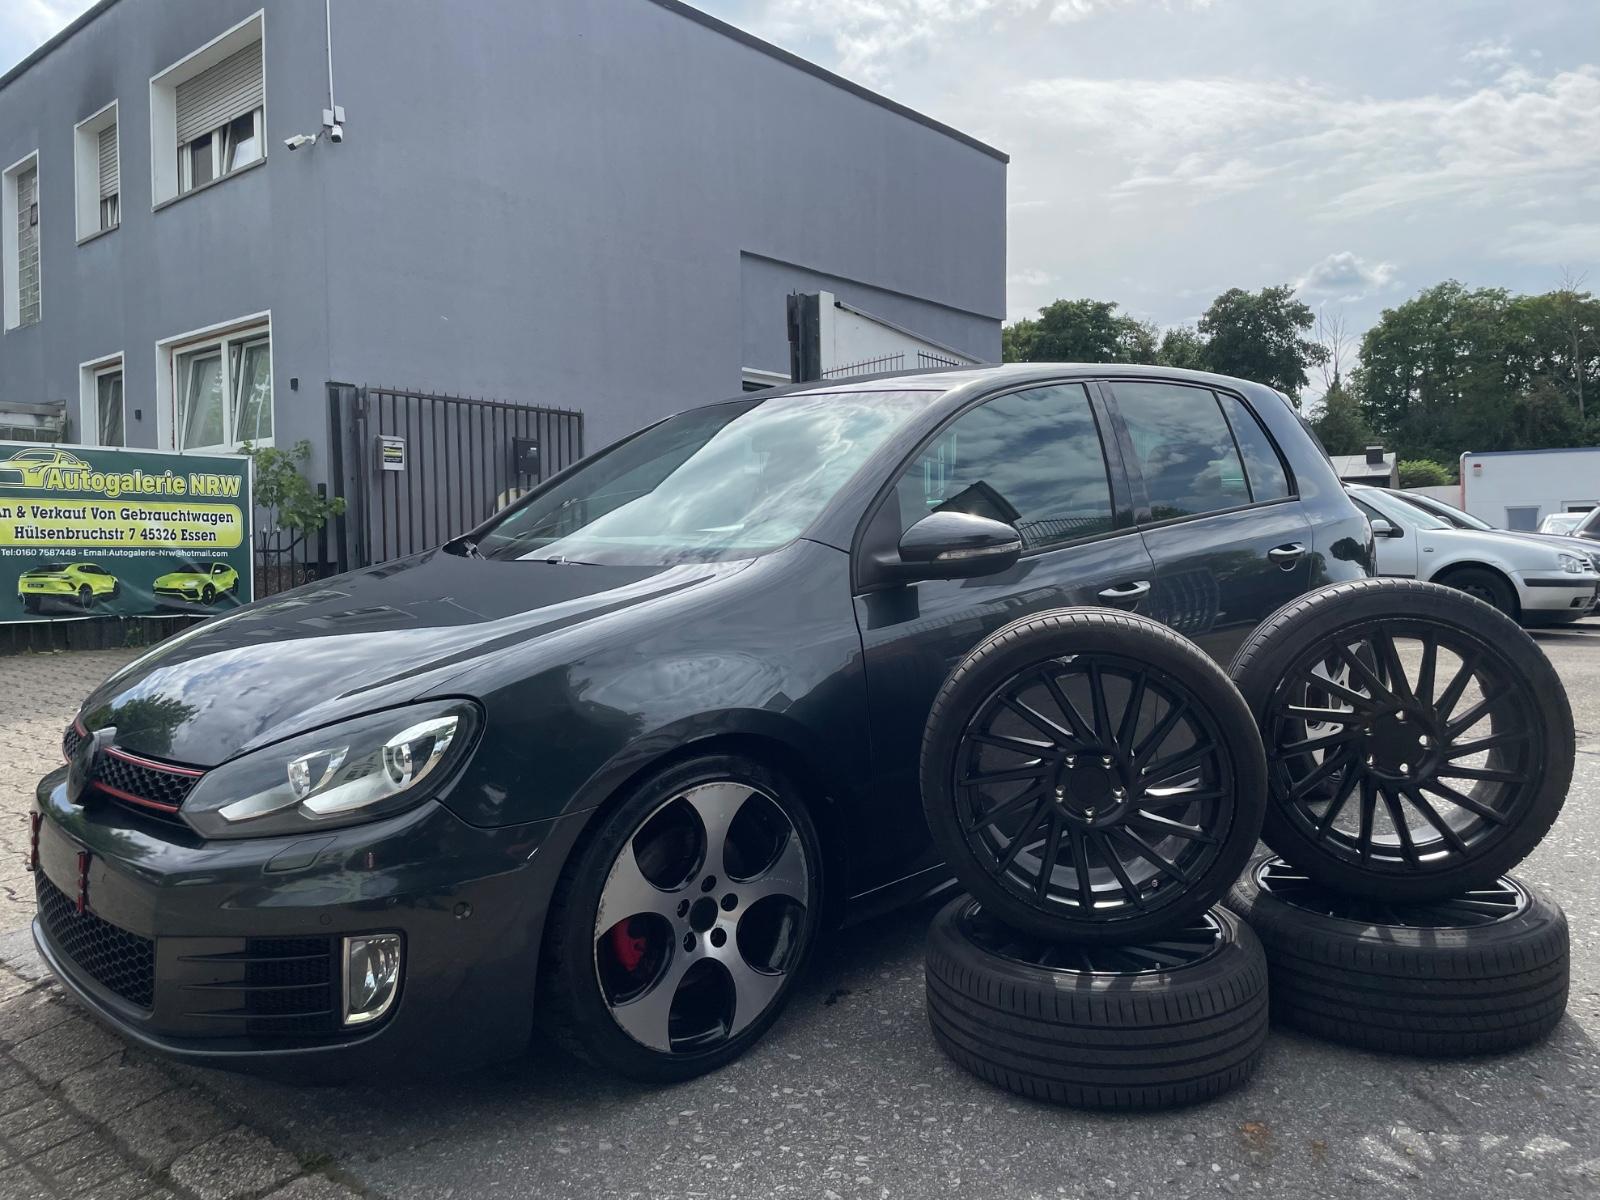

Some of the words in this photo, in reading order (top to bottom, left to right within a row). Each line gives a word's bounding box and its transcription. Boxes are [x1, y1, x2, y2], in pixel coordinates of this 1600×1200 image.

[46, 467, 187, 497] Autogalerie
[189, 473, 242, 497] NRW
[16, 506, 27, 518] &
[30, 506, 87, 519] Verkauf
[91, 507, 117, 520] Von
[120, 508, 234, 525] Gebrauchtwagen
[14, 525, 125, 540] Hülsenbruchstr
[129, 528, 136, 541] 7
[140, 528, 177, 541] 45326
[180, 529, 217, 541] Essen
